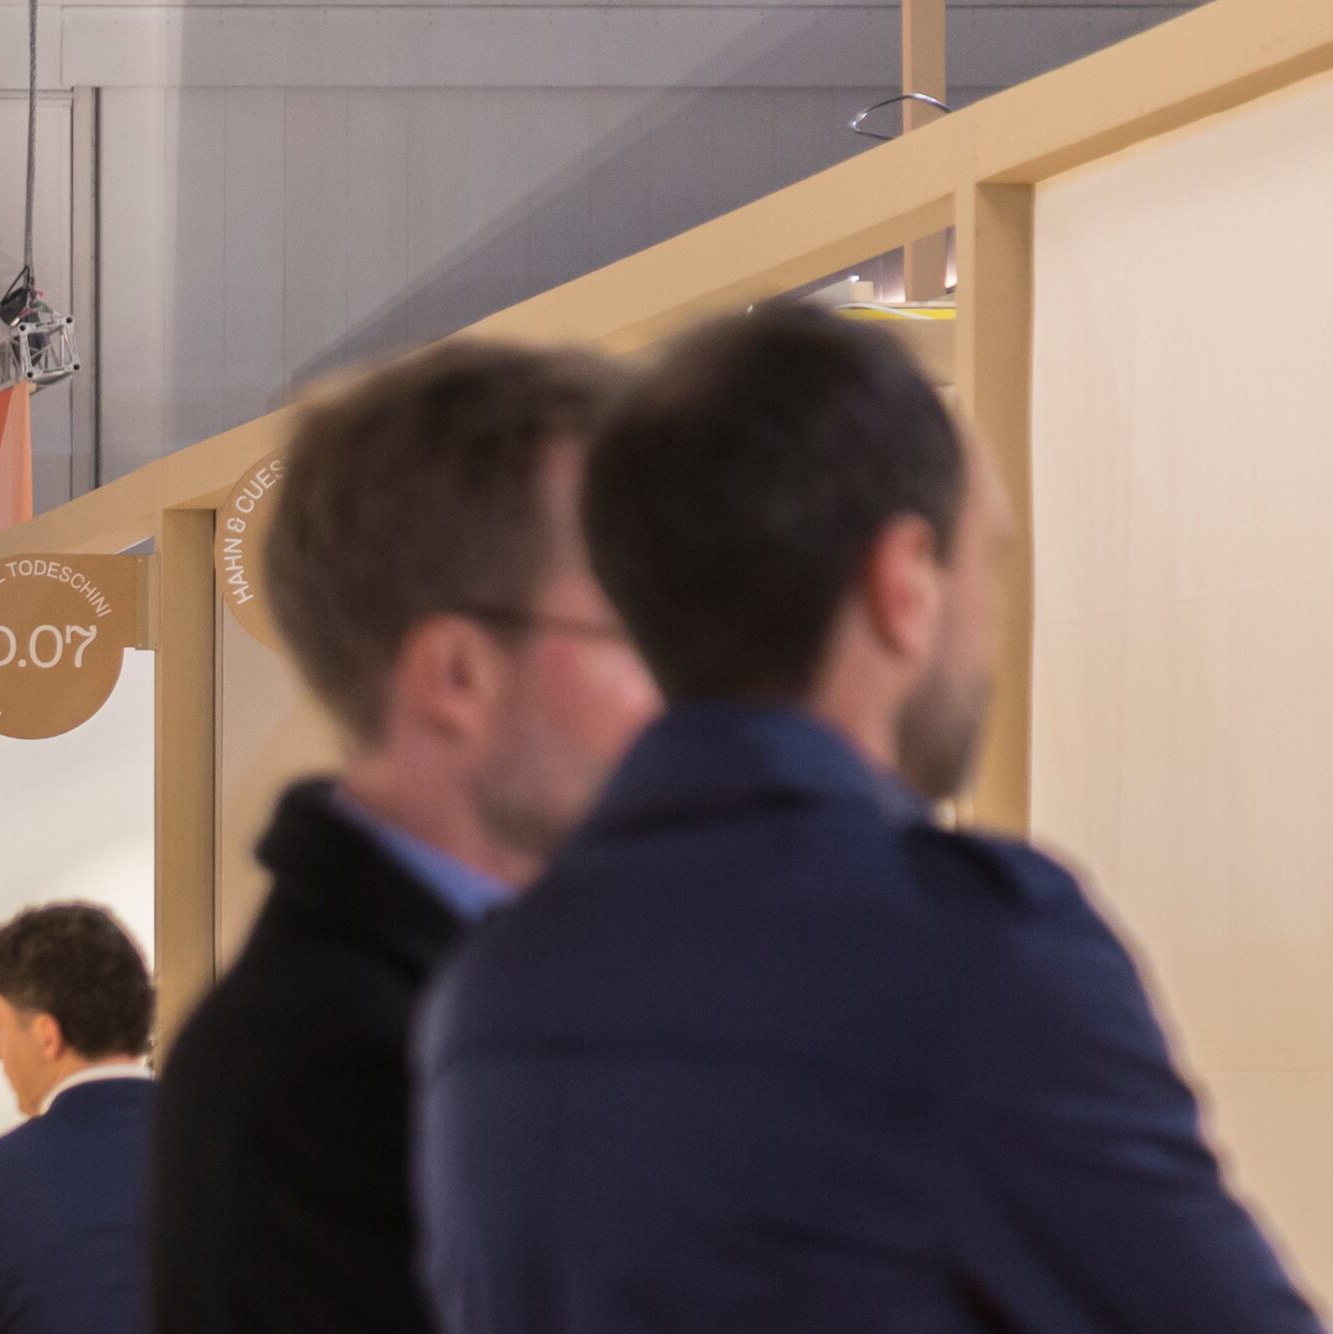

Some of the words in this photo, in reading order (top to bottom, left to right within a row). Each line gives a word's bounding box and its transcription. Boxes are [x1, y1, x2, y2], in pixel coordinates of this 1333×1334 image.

[235, 455, 286, 514] CUES
[227, 517, 246, 533] &
[5, 559, 112, 617] TODESCHINI
[223, 538, 254, 604] HAHN
